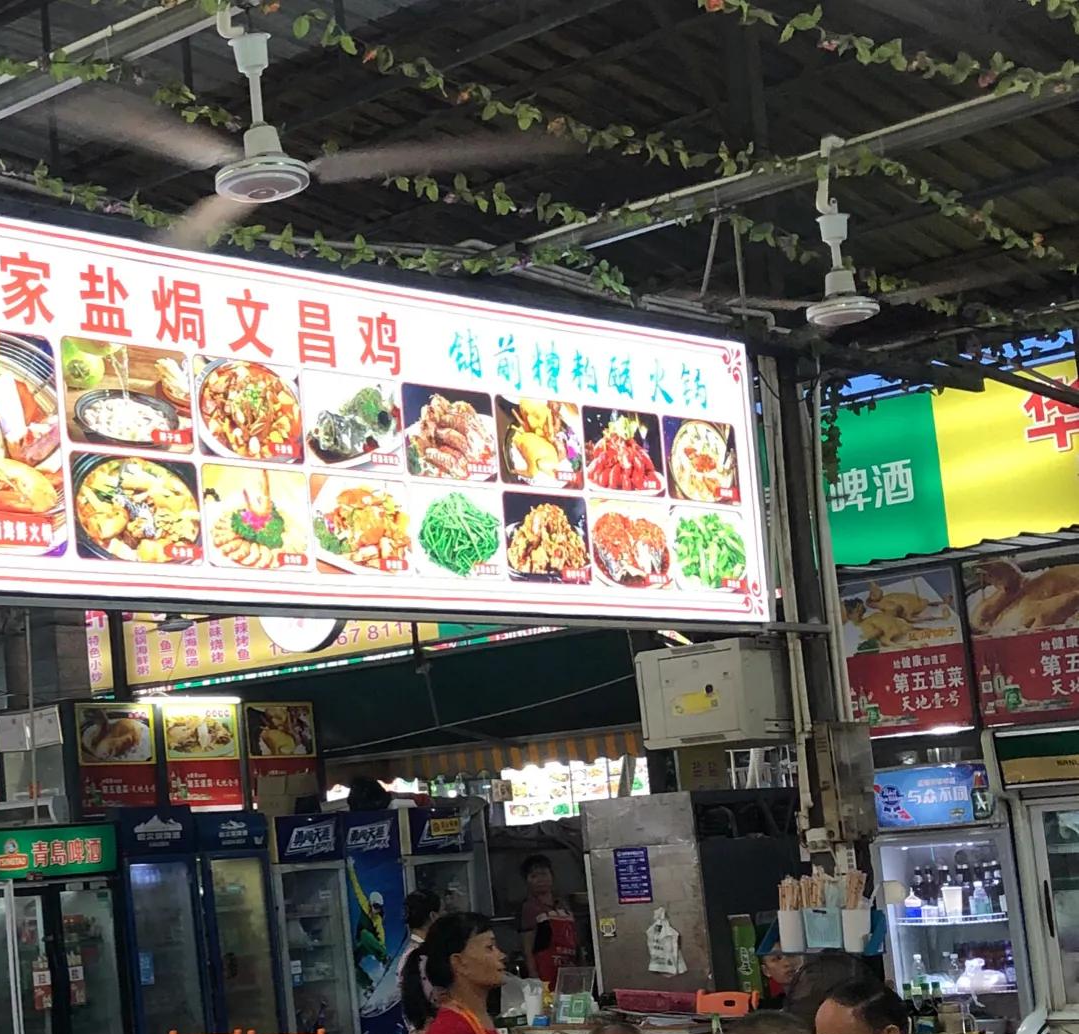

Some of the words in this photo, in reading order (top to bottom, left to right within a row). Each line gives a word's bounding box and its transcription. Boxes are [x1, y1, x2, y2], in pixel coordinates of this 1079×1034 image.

[830, 459, 914, 513] 啤酒
[893, 666, 965, 694] 第五道菜
[901, 690, 961, 712] 天地壹号
[31, 838, 102, 868] 青岛啤酒
